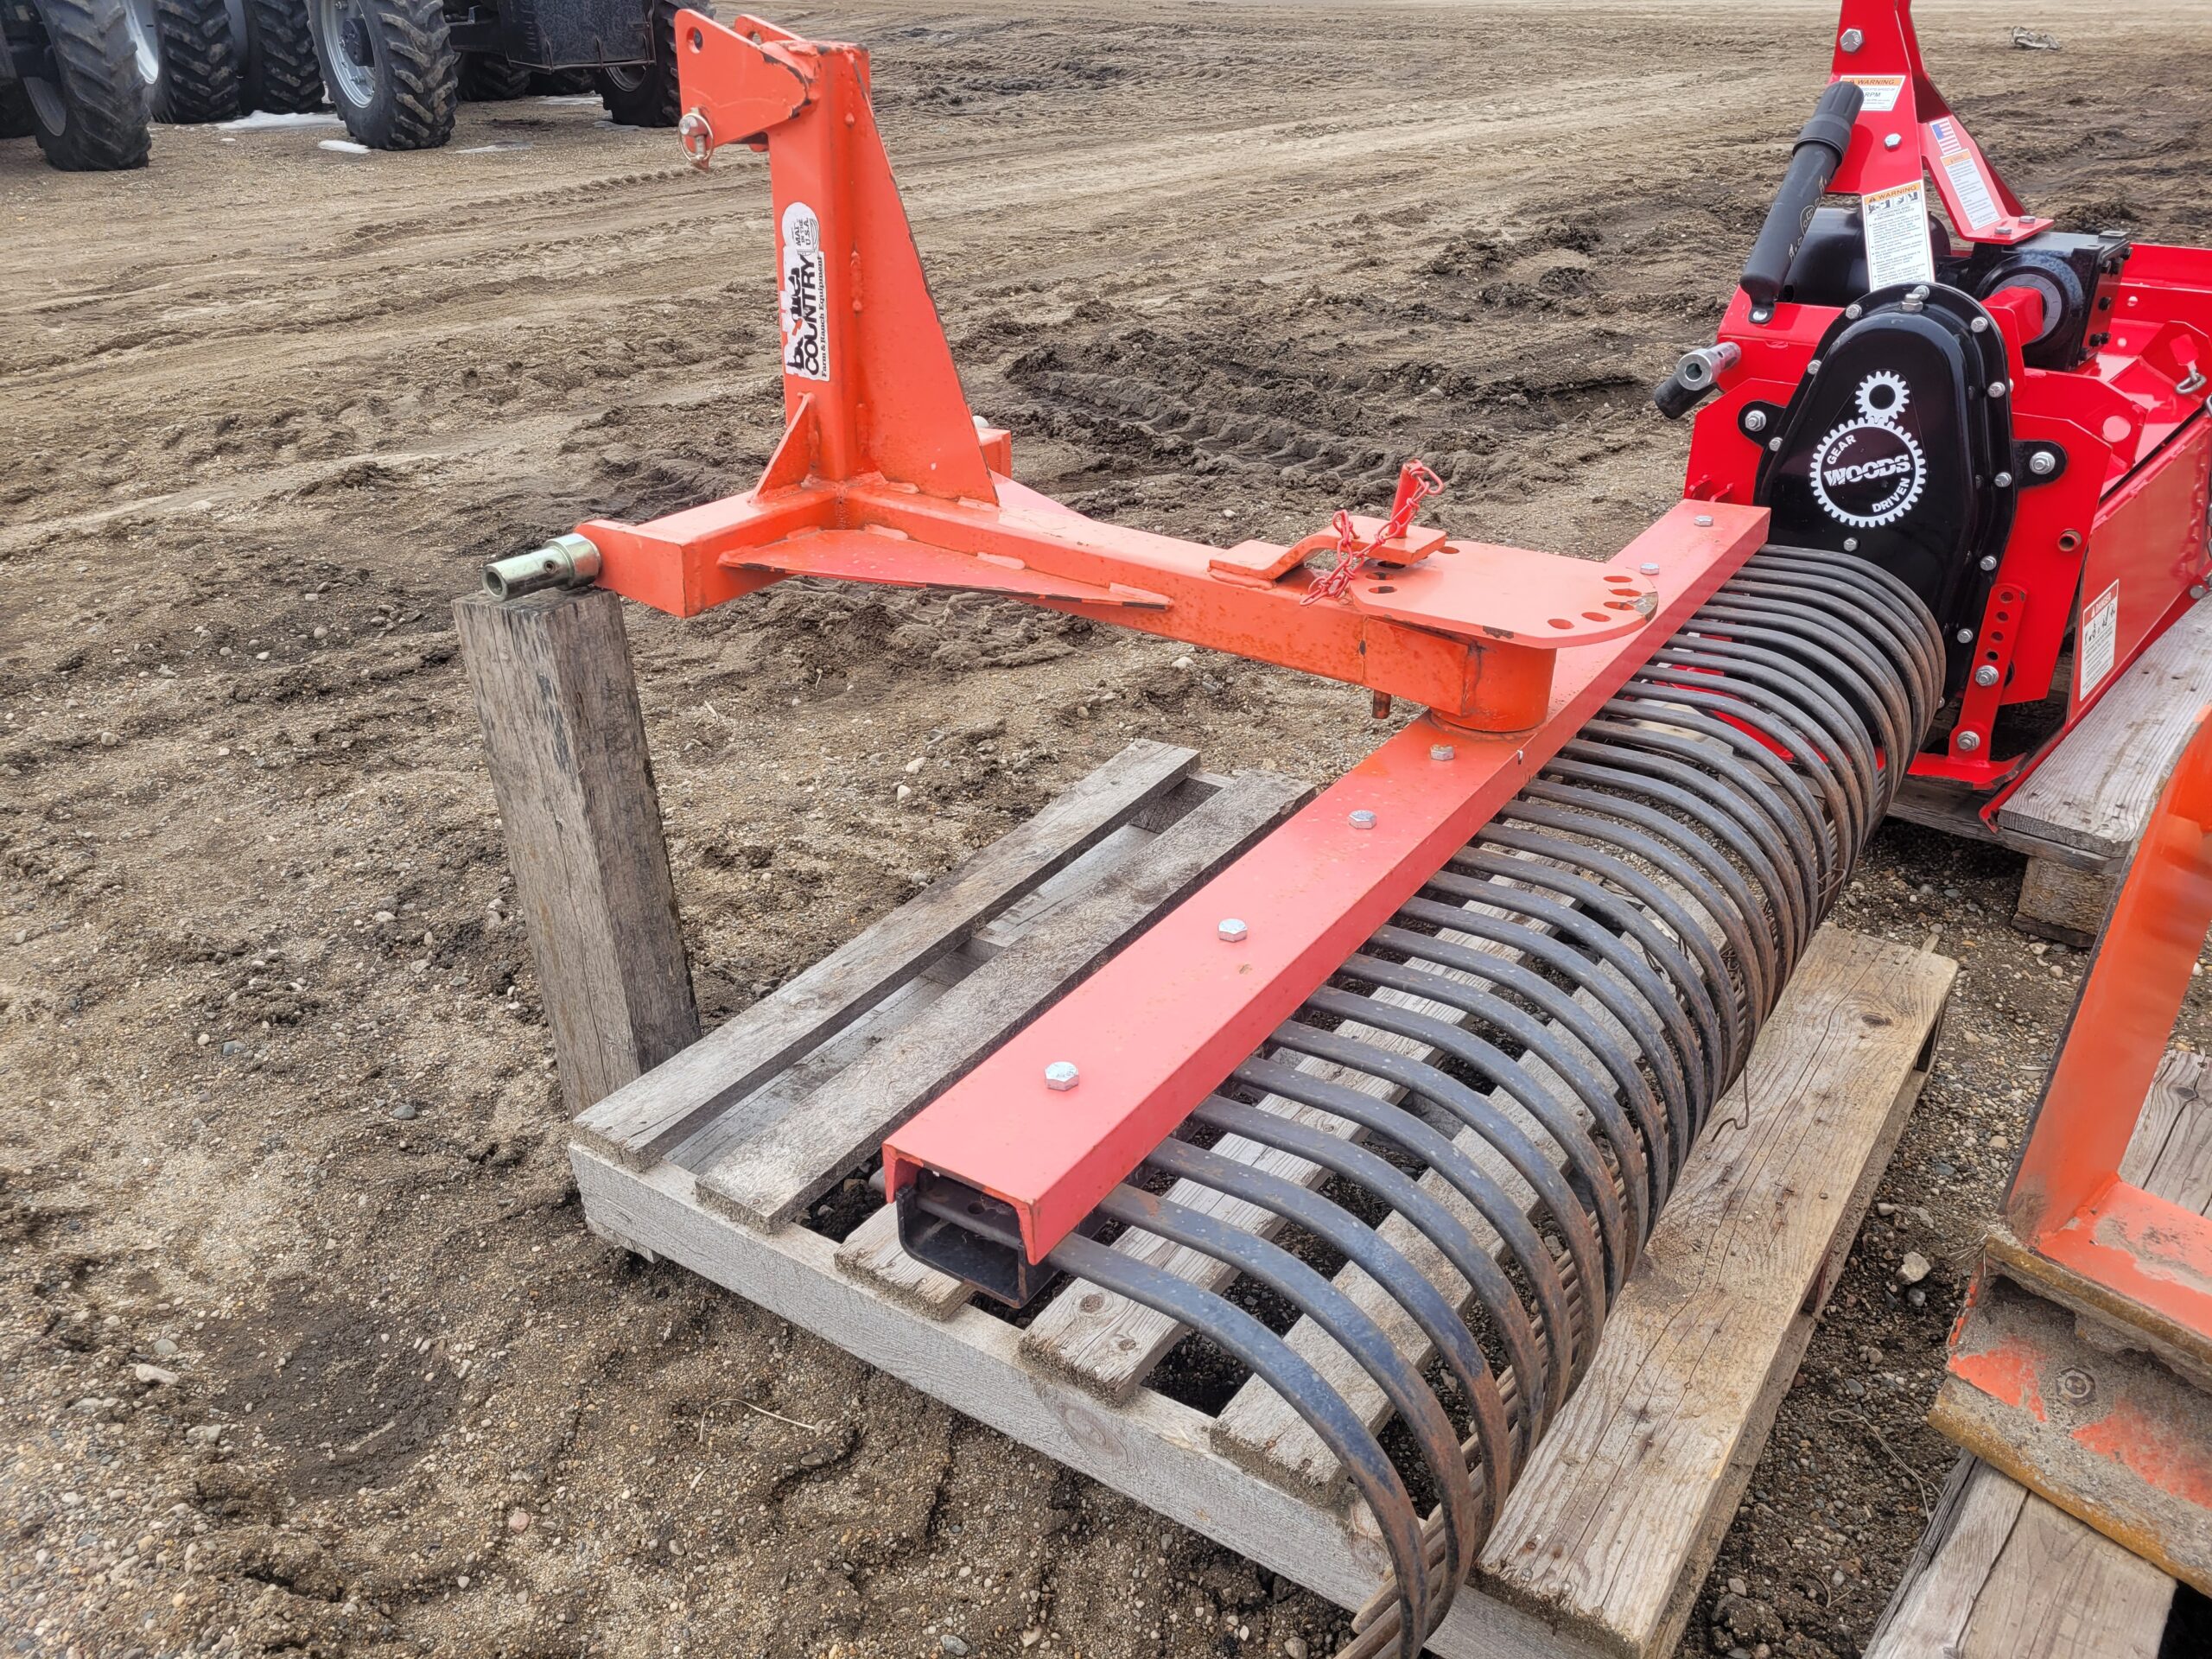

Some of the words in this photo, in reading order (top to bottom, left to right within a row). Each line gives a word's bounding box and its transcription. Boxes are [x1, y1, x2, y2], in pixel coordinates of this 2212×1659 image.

[1878, 184, 1917, 200] WARNING
[817, 257, 825, 310] Equipment
[799, 254, 819, 375] COUNTRY
[817, 314, 826, 344] Ranch
[1827, 435, 1857, 465] GEAR
[1823, 454, 1911, 486] WOODS
[1872, 477, 1910, 512] DRIVEN
